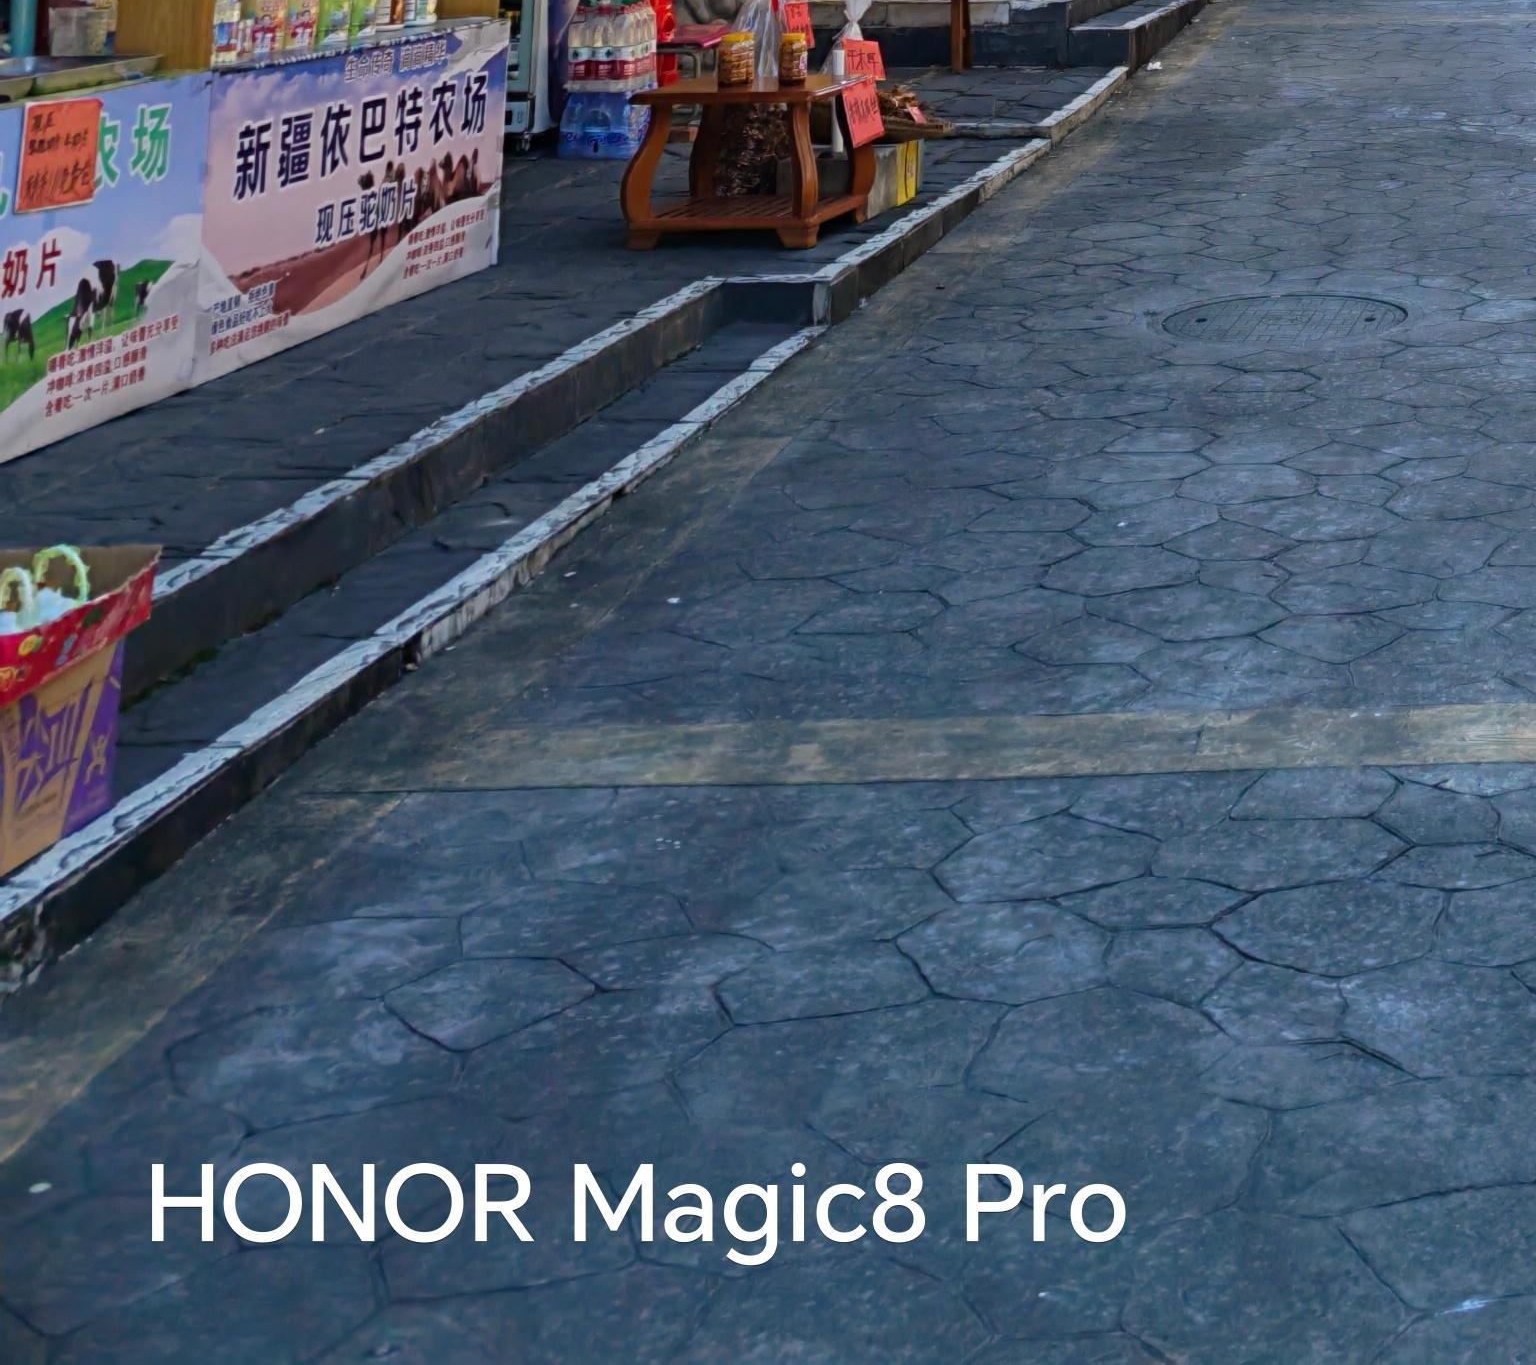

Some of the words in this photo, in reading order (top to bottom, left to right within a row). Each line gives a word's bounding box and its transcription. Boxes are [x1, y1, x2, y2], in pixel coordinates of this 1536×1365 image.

[233, 74, 488, 201] 新疆依巴特农场
[315, 180, 416, 245] 现压驼奶片
[1, 238, 62, 299] 奶片
